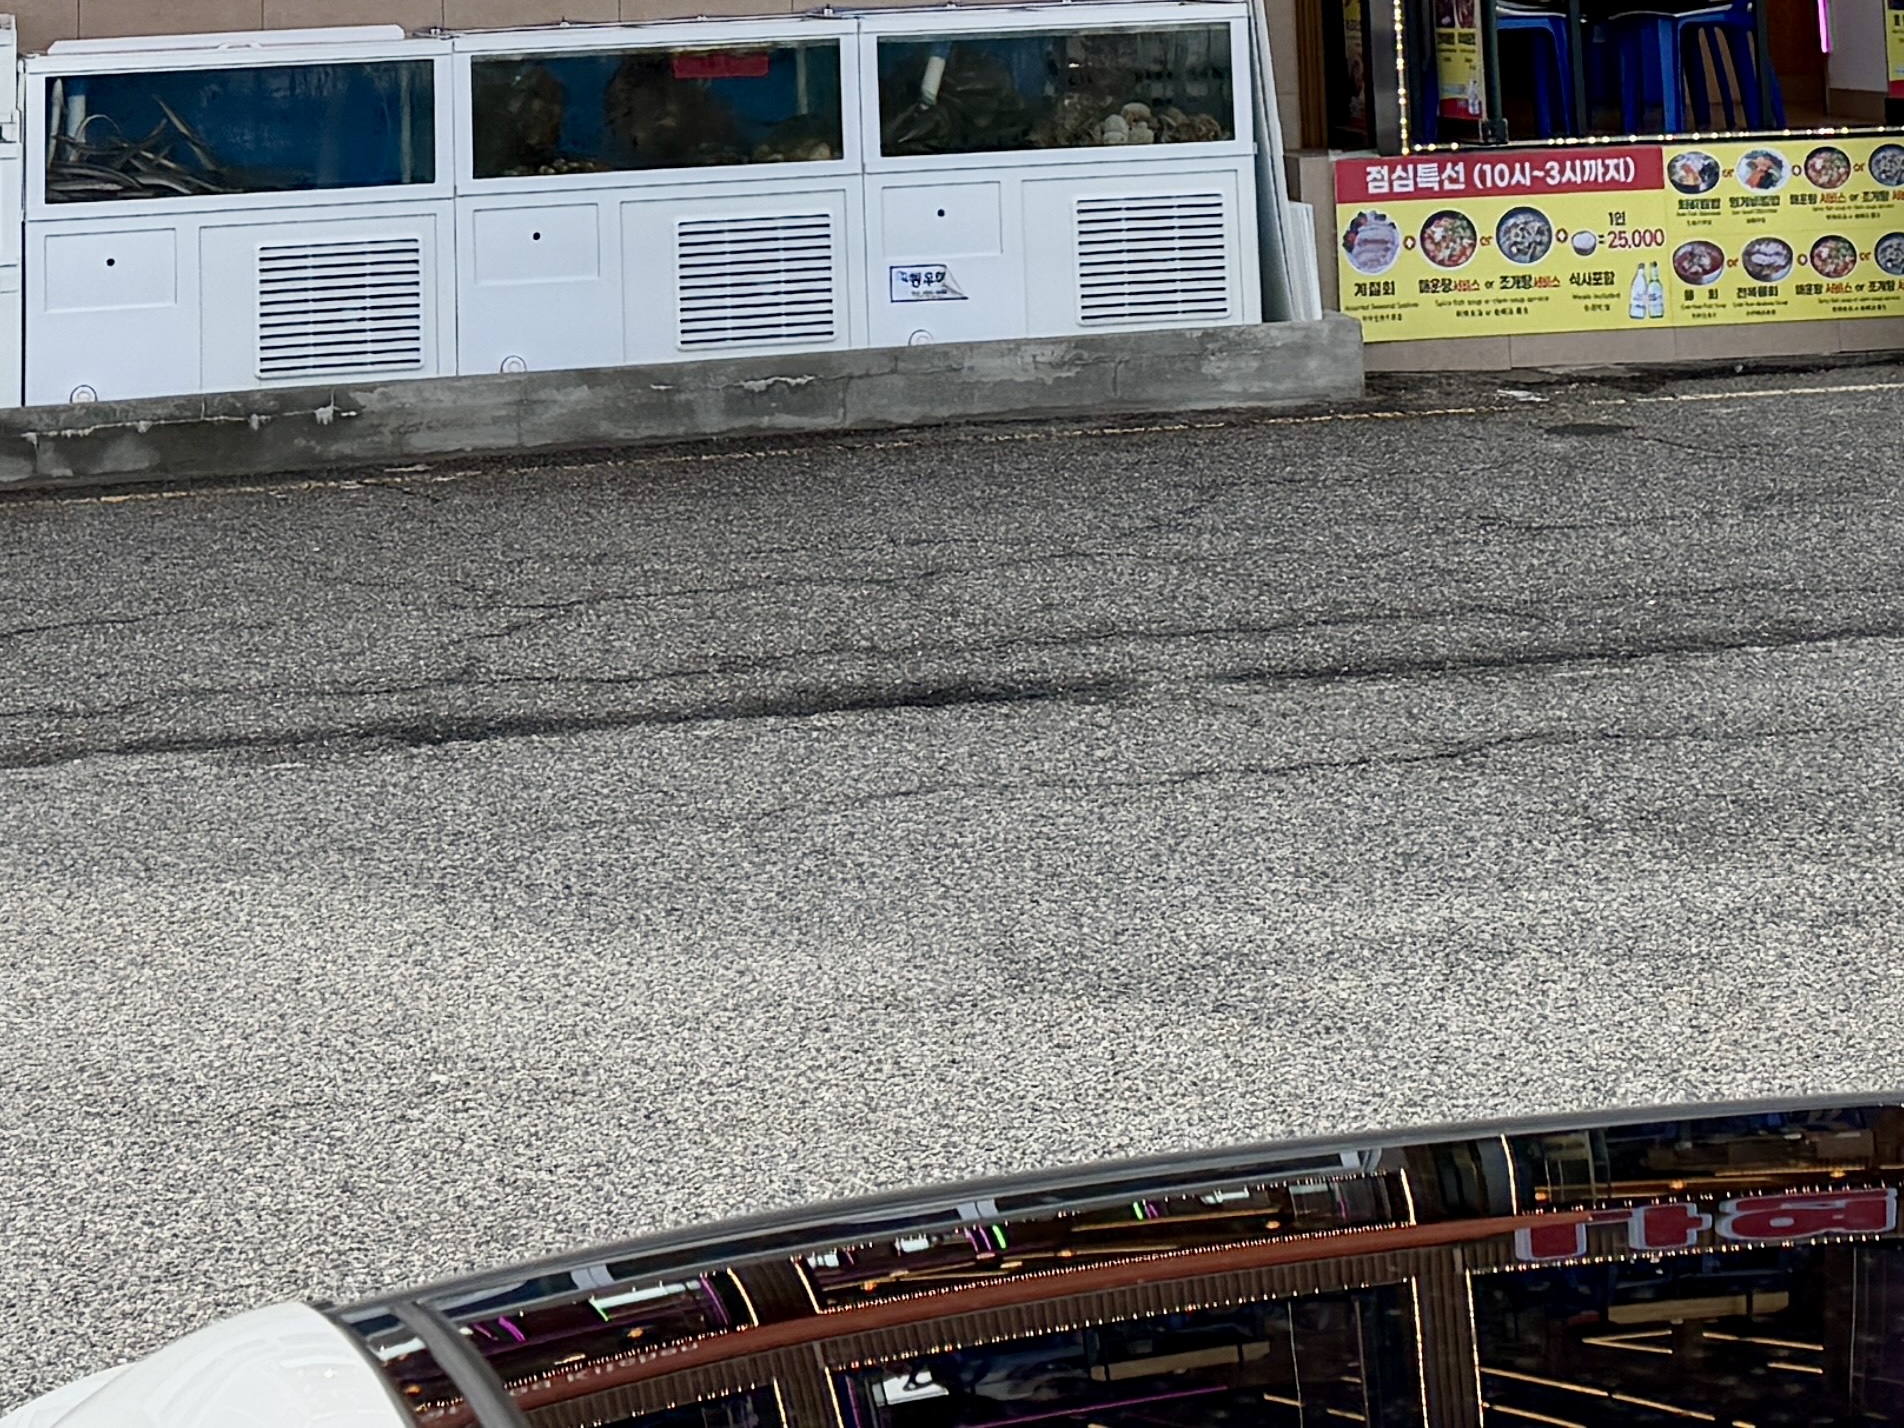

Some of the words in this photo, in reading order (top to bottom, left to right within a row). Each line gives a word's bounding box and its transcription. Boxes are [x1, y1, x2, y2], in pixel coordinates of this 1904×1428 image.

[1365, 160, 1466, 194] 점심특선
[1472, 155, 1636, 191] (10시~3시까지)
[1607, 228, 1666, 249] 25,000
[1569, 271, 1616, 287] 식사포함
